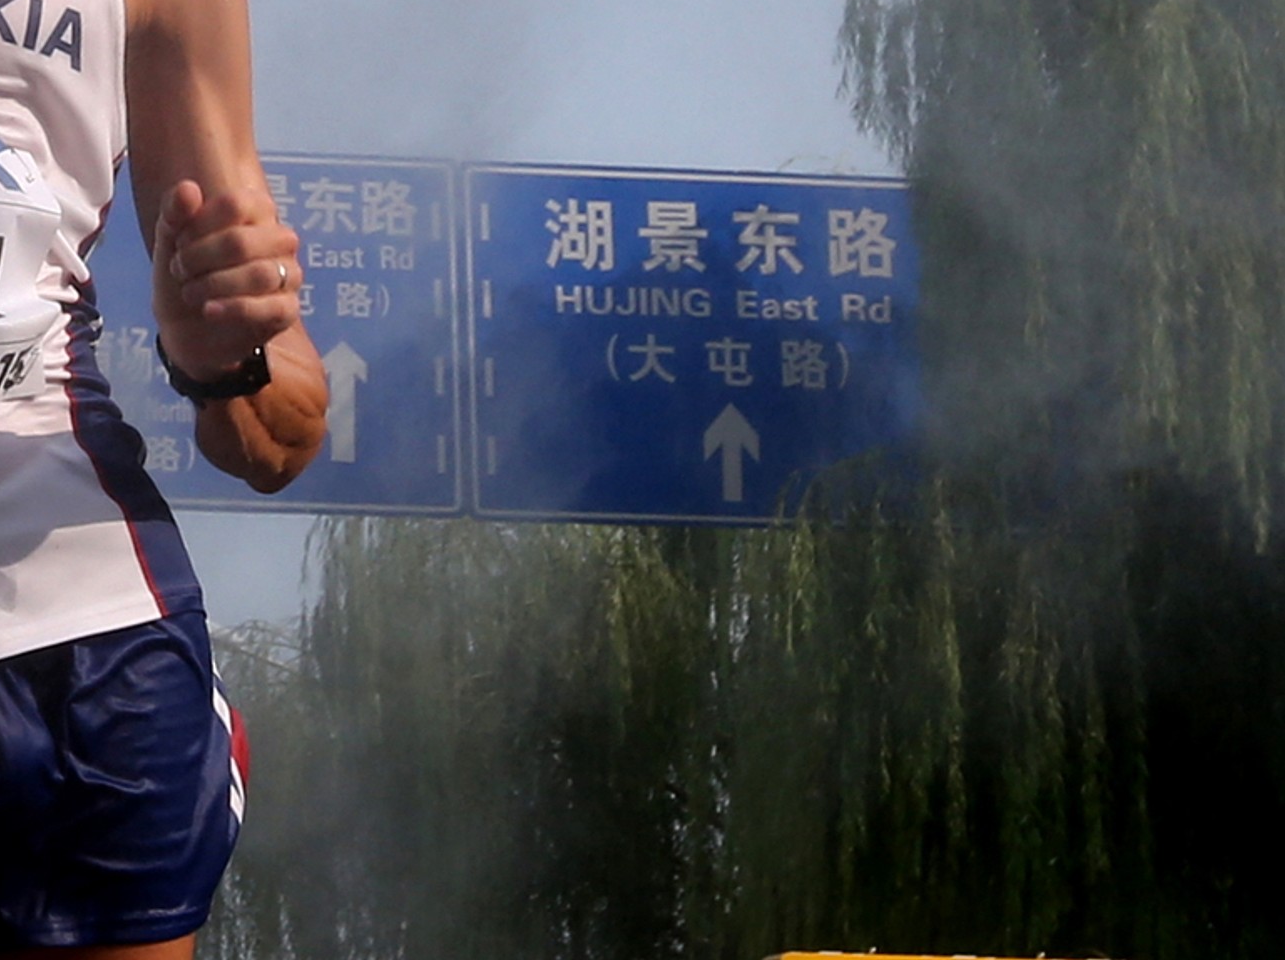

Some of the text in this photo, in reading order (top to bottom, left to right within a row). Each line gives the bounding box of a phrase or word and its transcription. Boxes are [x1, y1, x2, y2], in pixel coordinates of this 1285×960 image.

[307, 243, 414, 271] East Rd
[544, 198, 897, 279] 湖景东路
[555, 285, 893, 324] HUJING East Rd
